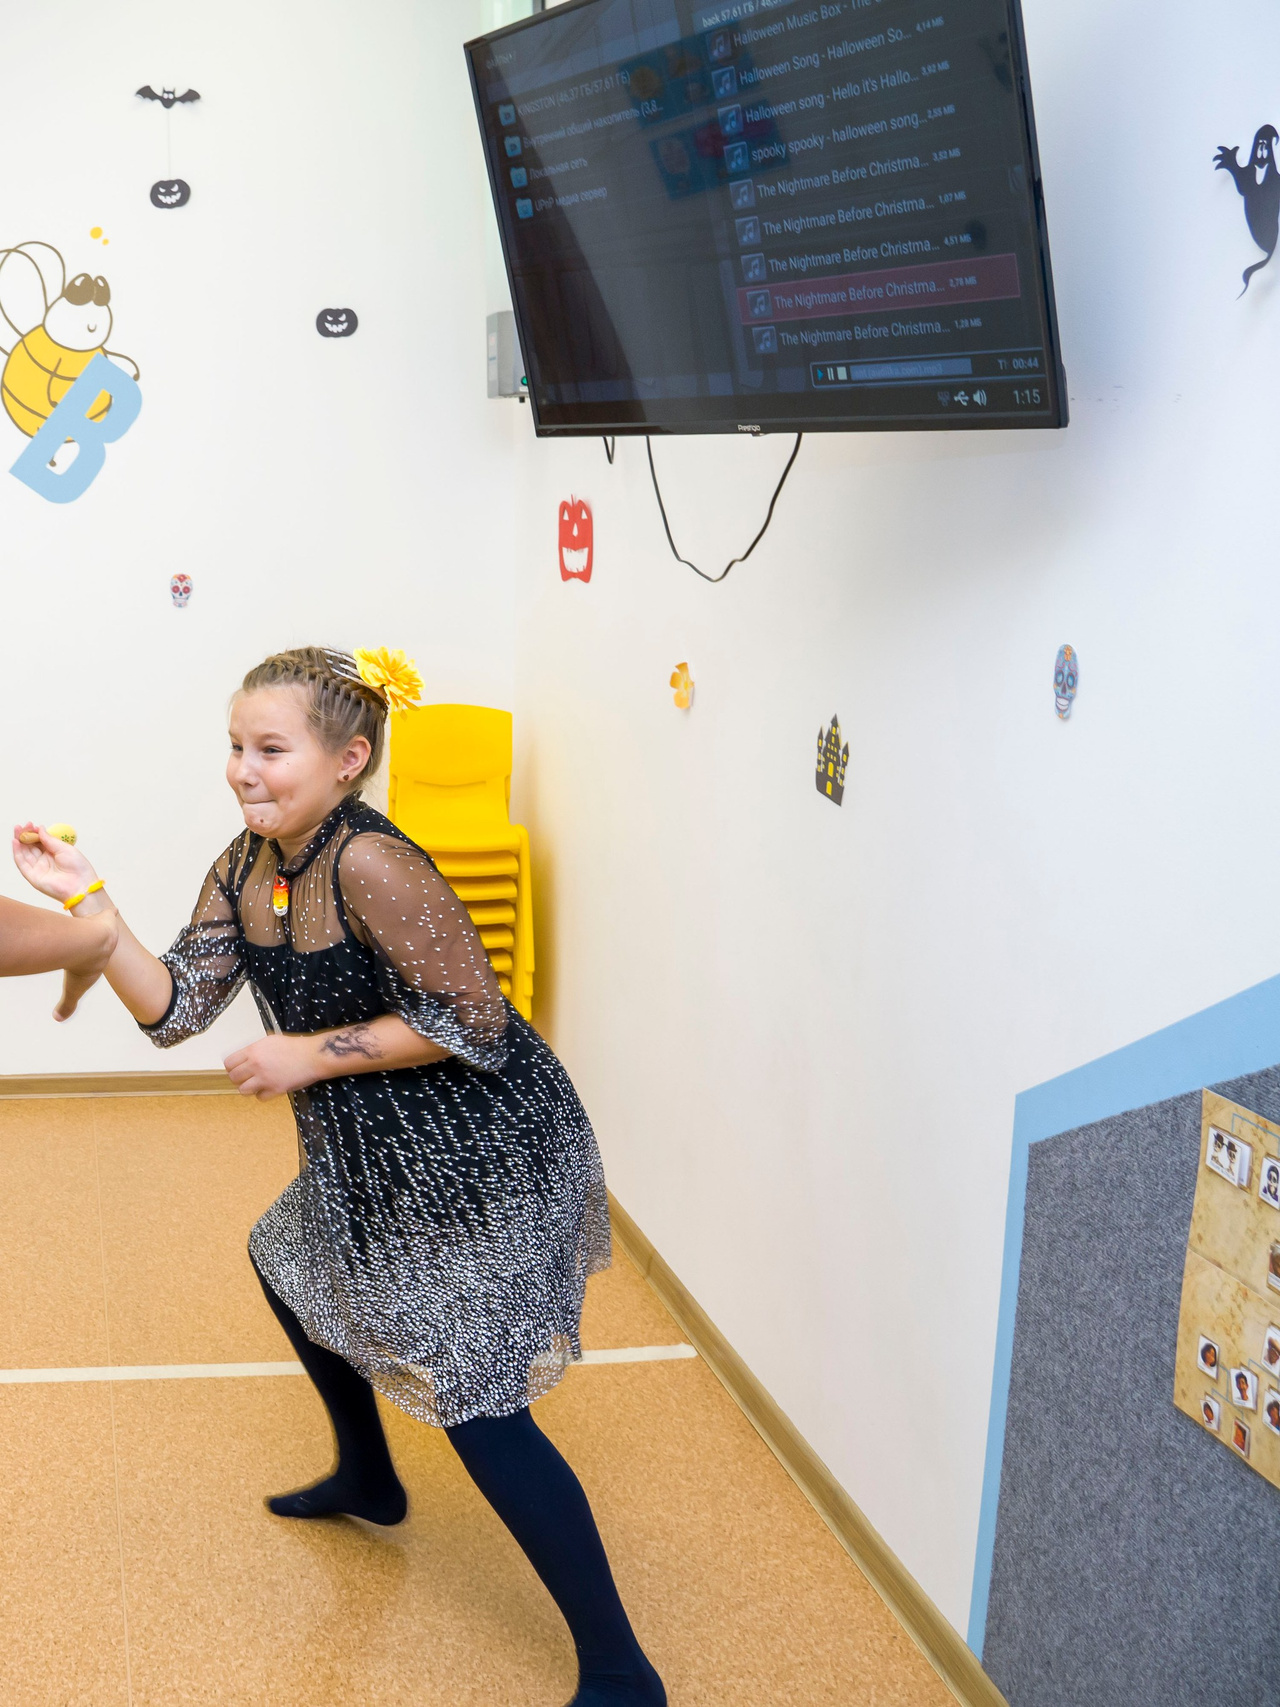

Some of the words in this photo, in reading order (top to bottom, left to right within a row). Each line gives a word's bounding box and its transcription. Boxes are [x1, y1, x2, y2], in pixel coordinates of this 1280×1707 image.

[733, 21, 785, 47] Halloween
[785, 10, 819, 31] Music
[820, 4, 841, 20] Box
[739, 60, 791, 85] Halloween
[792, 52, 820, 70] Song
[827, 33, 885, 60] Halloween
[887, 27, 912, 44] So...
[745, 101, 796, 123] Halloween
[799, 93, 825, 110] song
[832, 83, 860, 101] Hello
[862, 78, 878, 94] it's
[880, 69, 918, 89] Hallo...
[752, 142, 786, 162] spooky
[788, 133, 824, 155] spooky
[832, 120, 887, 142] halloween
[889, 112, 927, 129] song...
[757, 184, 776, 198] The
[777, 174, 830, 196] Nightmare
[832, 165, 867, 184] Before
[869, 155, 929, 177] Christma...
[763, 221, 782, 235] The
[783, 213, 836, 234] Nightmare
[837, 205, 873, 224] Before
[875, 198, 934, 217] Christma...
[768, 259, 787, 273] The
[789, 251, 841, 272] Nightmare
[843, 245, 878, 263] Before
[880, 240, 940, 257] Christma...
[774, 295, 793, 309] The
[794, 289, 847, 309] Nightmare
[848, 285, 884, 301] Before
[886, 280, 945, 298] Christma...
[780, 332, 799, 346] The
[800, 327, 852, 347] Nightmare
[854, 323, 889, 340] Before
[891, 321, 951, 338] Christma...
[1012, 357, 1039, 370] 00:44
[1013, 388, 1041, 405] 1:15
[8, 352, 142, 504] B
